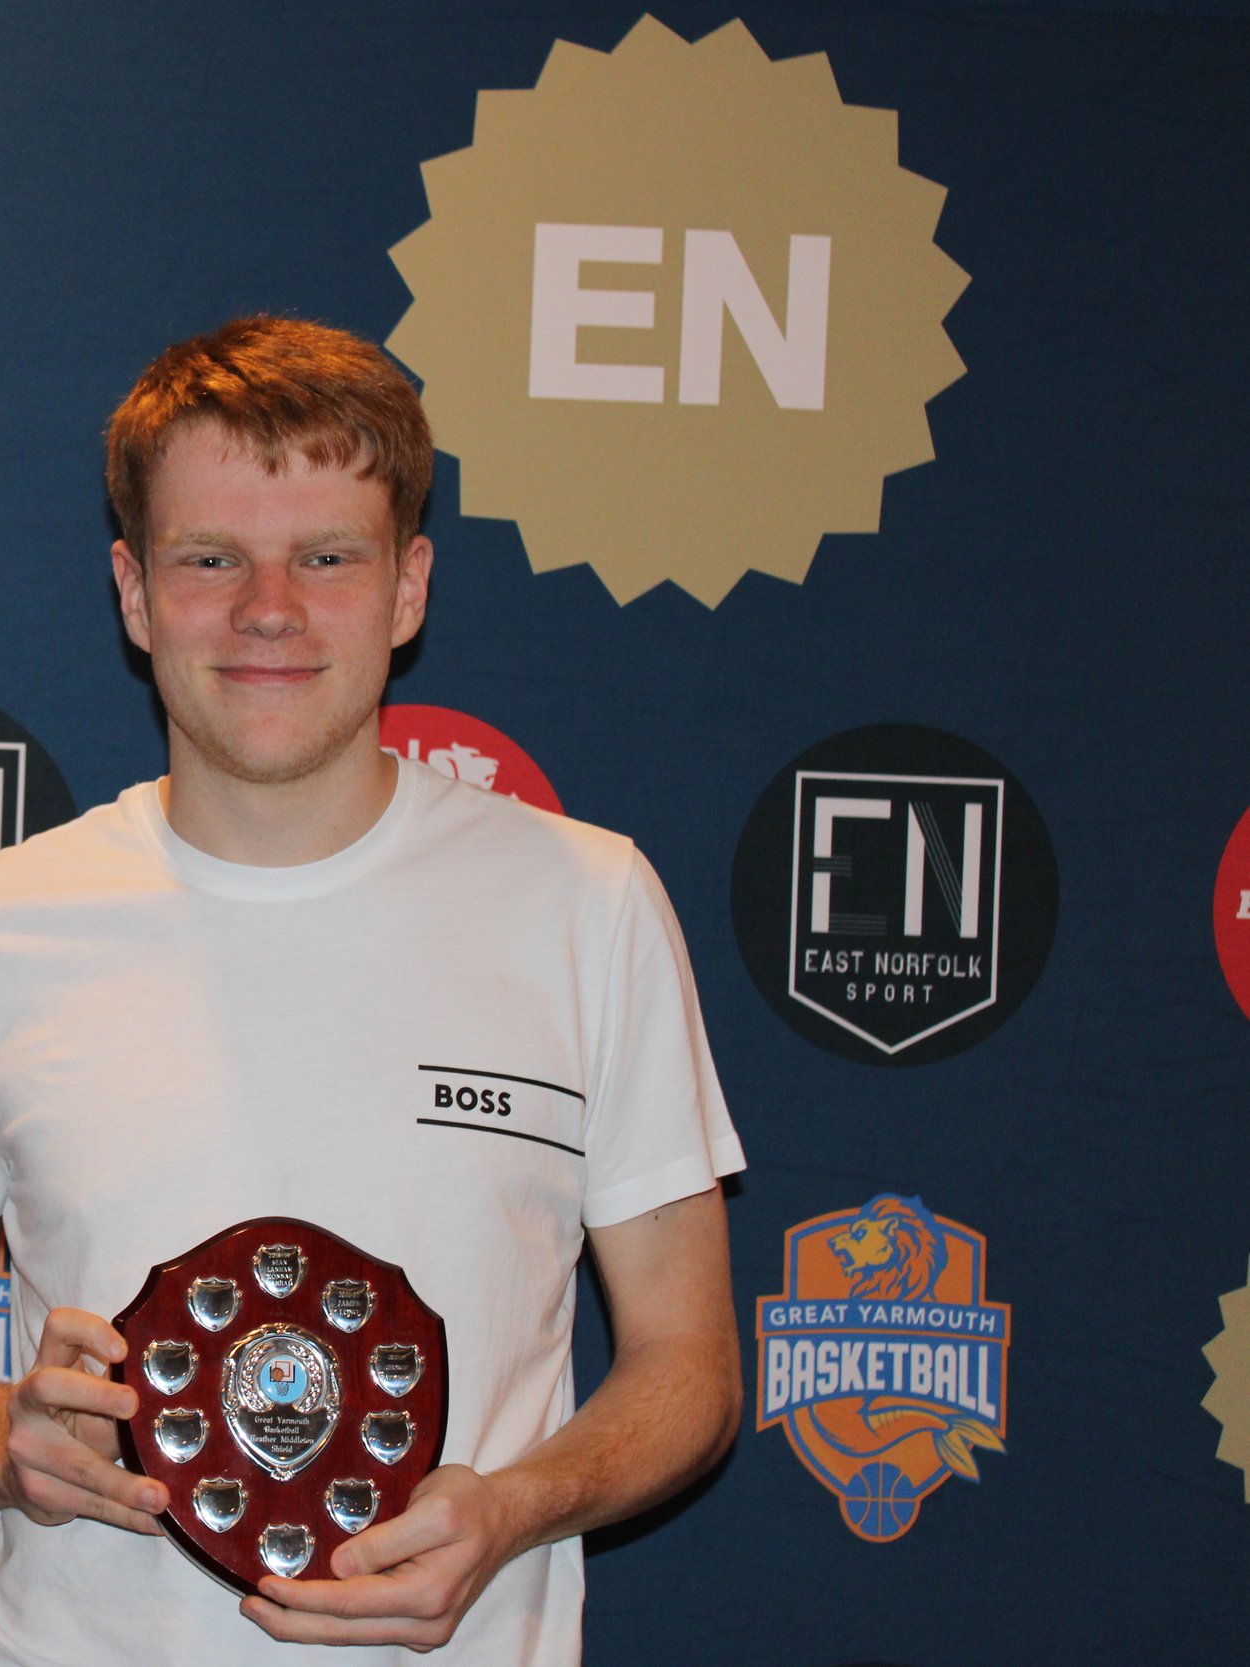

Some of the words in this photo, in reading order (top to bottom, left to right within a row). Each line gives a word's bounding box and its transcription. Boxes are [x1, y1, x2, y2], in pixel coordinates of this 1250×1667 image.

[528, 222, 832, 411] EN
[805, 949, 864, 974] EAST
[875, 951, 981, 978] NORFOLK
[846, 983, 933, 1004] SPORT
[434, 1083, 512, 1117] BOSS
[770, 1305, 848, 1326] GREAT
[858, 1305, 995, 1333] YARMOUTH
[767, 1339, 996, 1420] BASKETBALL
[254, 1416, 273, 1424] Great
[277, 1416, 310, 1425] Yarmouth
[264, 1425, 299, 1434] Basketball
[250, 1434, 276, 1443] Heather
[280, 1435, 314, 1444] Middleton
[271, 1444, 293, 1453] Shield
